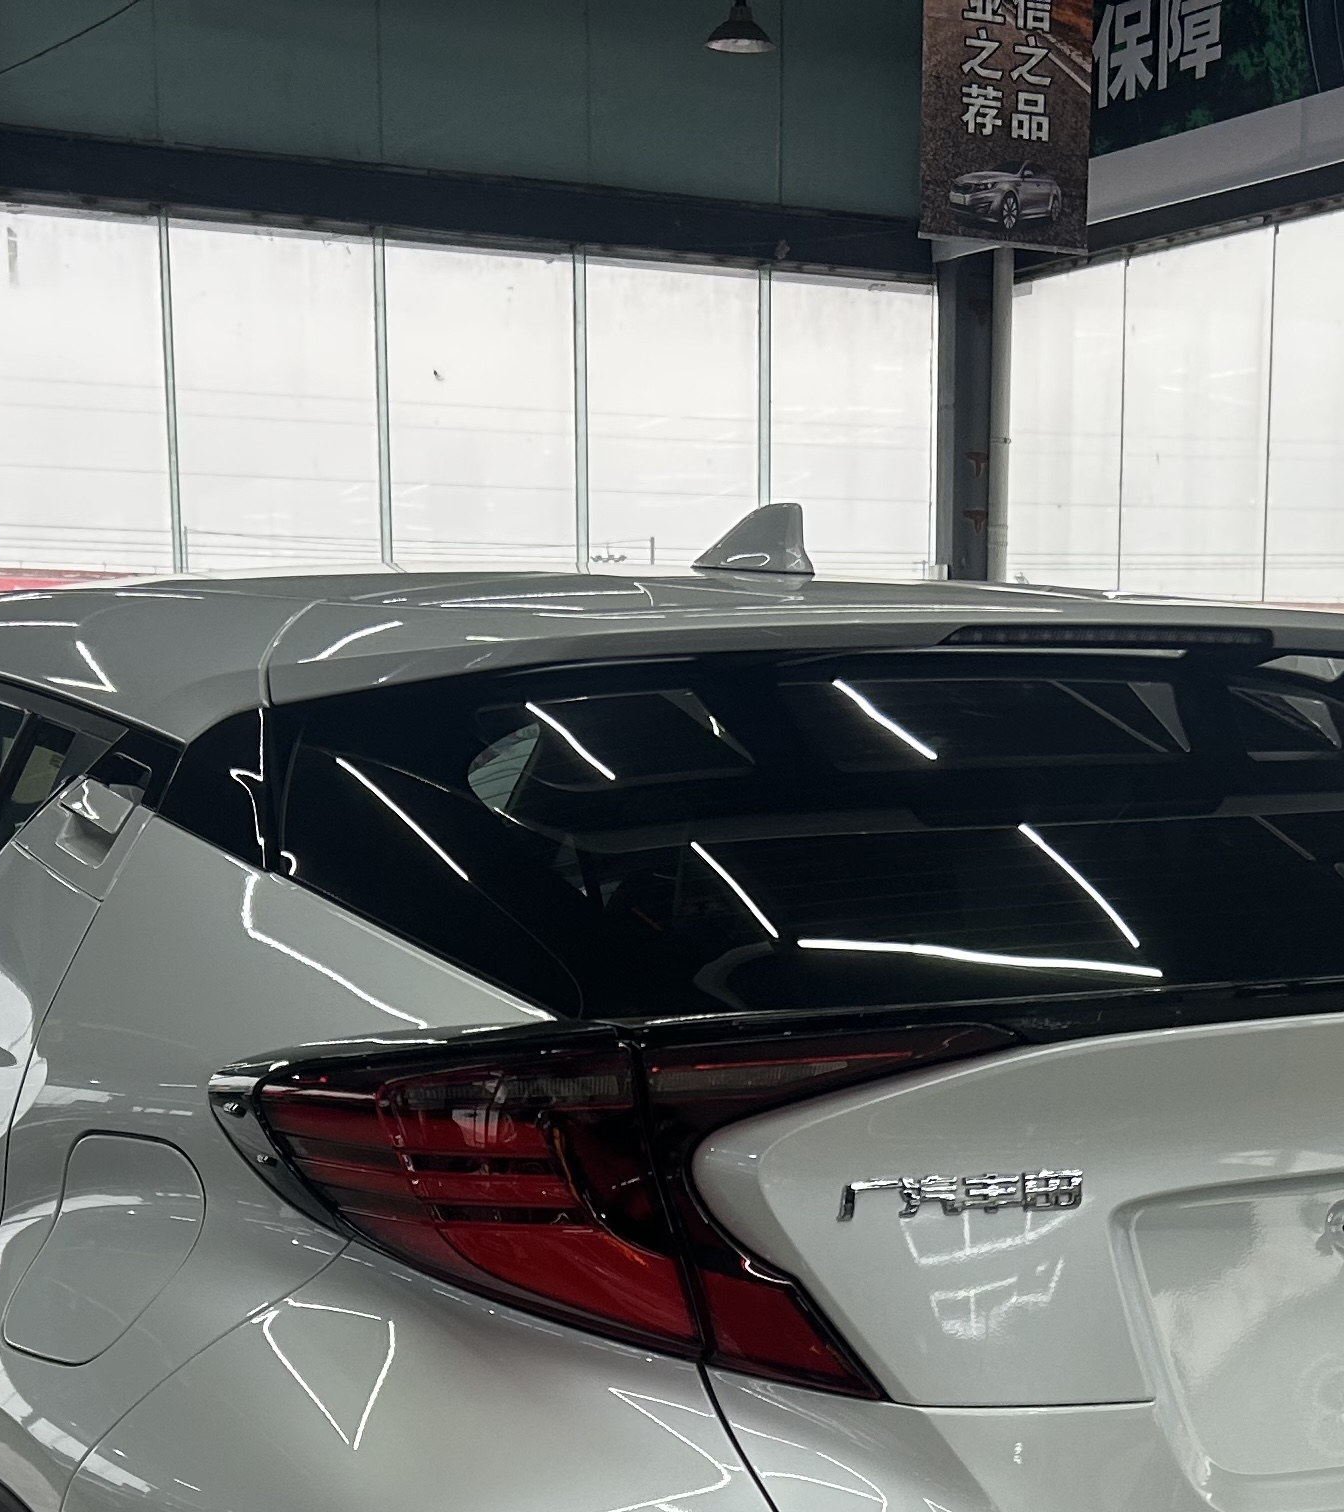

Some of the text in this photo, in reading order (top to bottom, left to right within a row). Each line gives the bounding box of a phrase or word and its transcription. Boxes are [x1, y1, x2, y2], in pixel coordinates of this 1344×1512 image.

[1010, 0, 1052, 142] 信之品
[1092, 0, 1222, 109] 保障
[837, 1169, 1083, 1222] 广汽丰田
